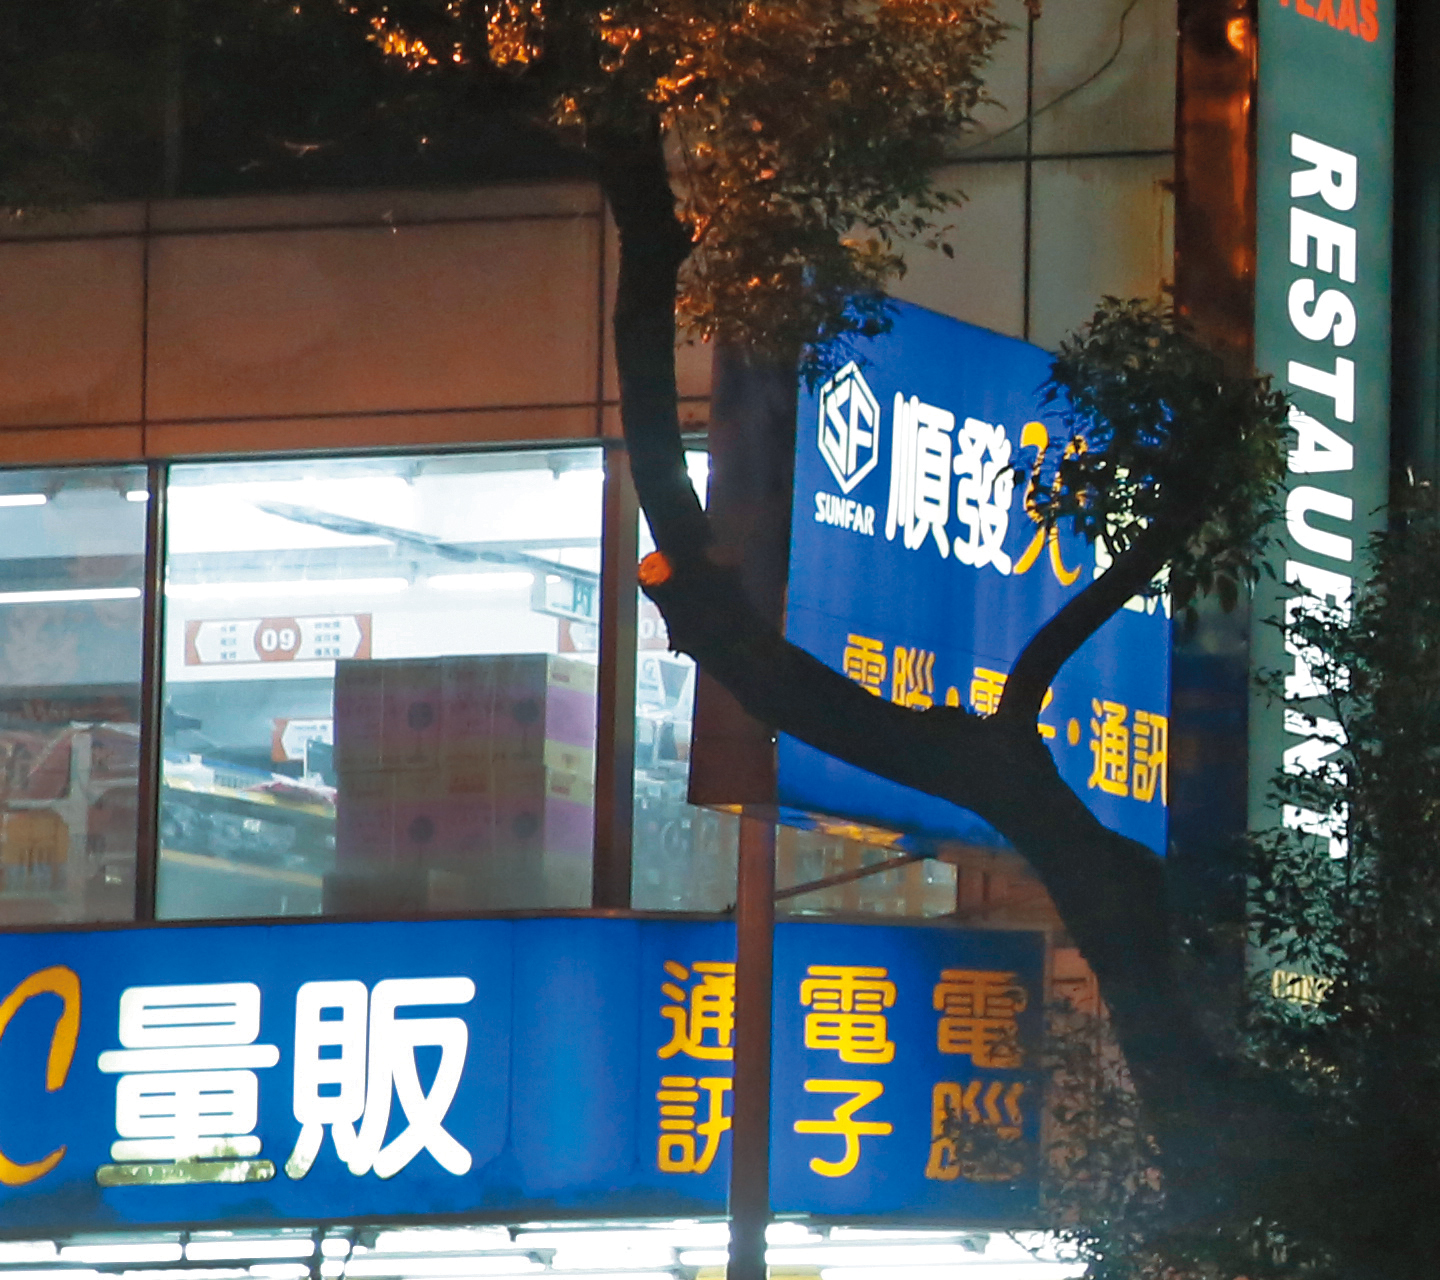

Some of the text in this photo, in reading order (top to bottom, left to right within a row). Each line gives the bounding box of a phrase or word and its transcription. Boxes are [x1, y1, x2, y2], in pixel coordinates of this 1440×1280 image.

[814, 491, 876, 537] SUNFAR
[260, 628, 297, 652] 09
[794, 966, 897, 1177] 電子
